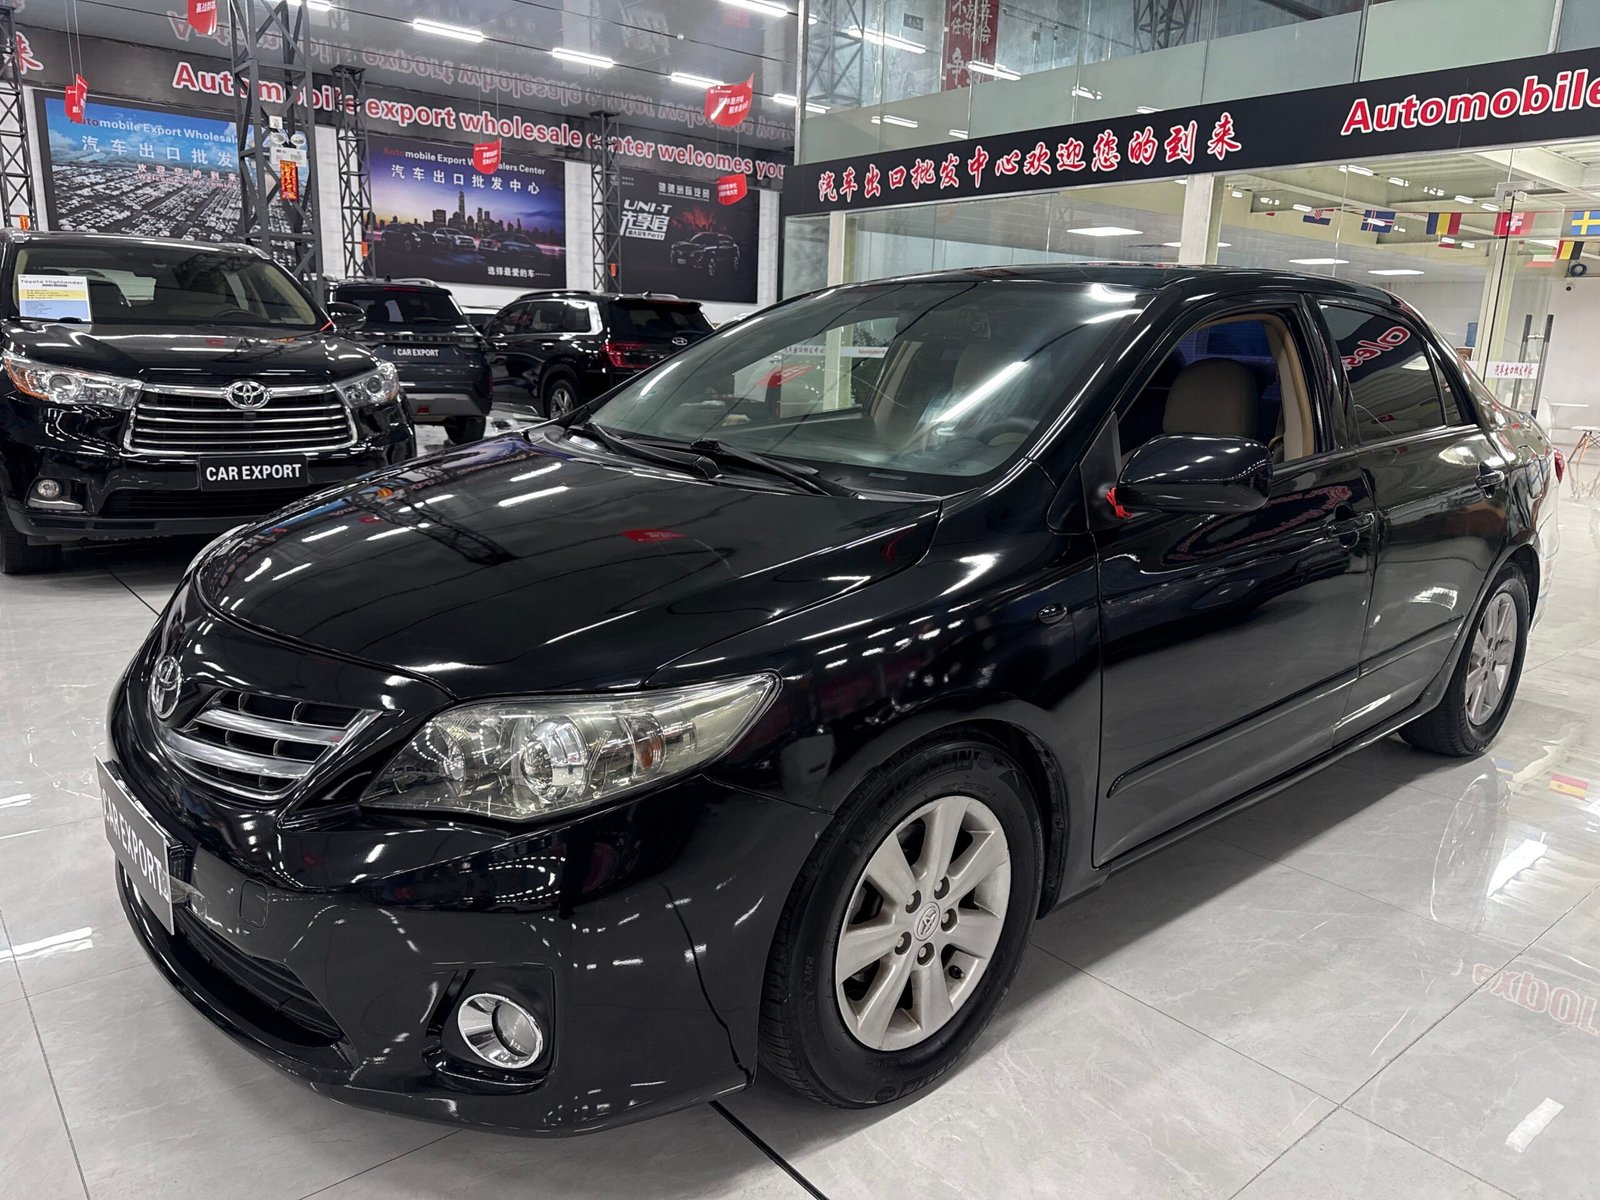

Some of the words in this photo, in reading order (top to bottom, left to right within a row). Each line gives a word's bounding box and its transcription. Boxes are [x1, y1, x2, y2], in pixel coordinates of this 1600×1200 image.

[143, 123, 182, 138] Export
[365, 98, 456, 127] export
[459, 111, 583, 149] wholesale
[658, 144, 752, 175] welcomes
[384, 146, 436, 162] Automobile
[437, 153, 466, 166] Export
[519, 164, 546, 176] Center
[391, 163, 540, 195] 汽车出口批发中心
[623, 199, 672, 214] UNI-T
[397, 348, 412, 357] CAR
[413, 348, 440, 357] EXPORT
[206, 466, 239, 481] CAR
[241, 463, 302, 480] EXPORT
[119, 812, 162, 896] EXPORT
